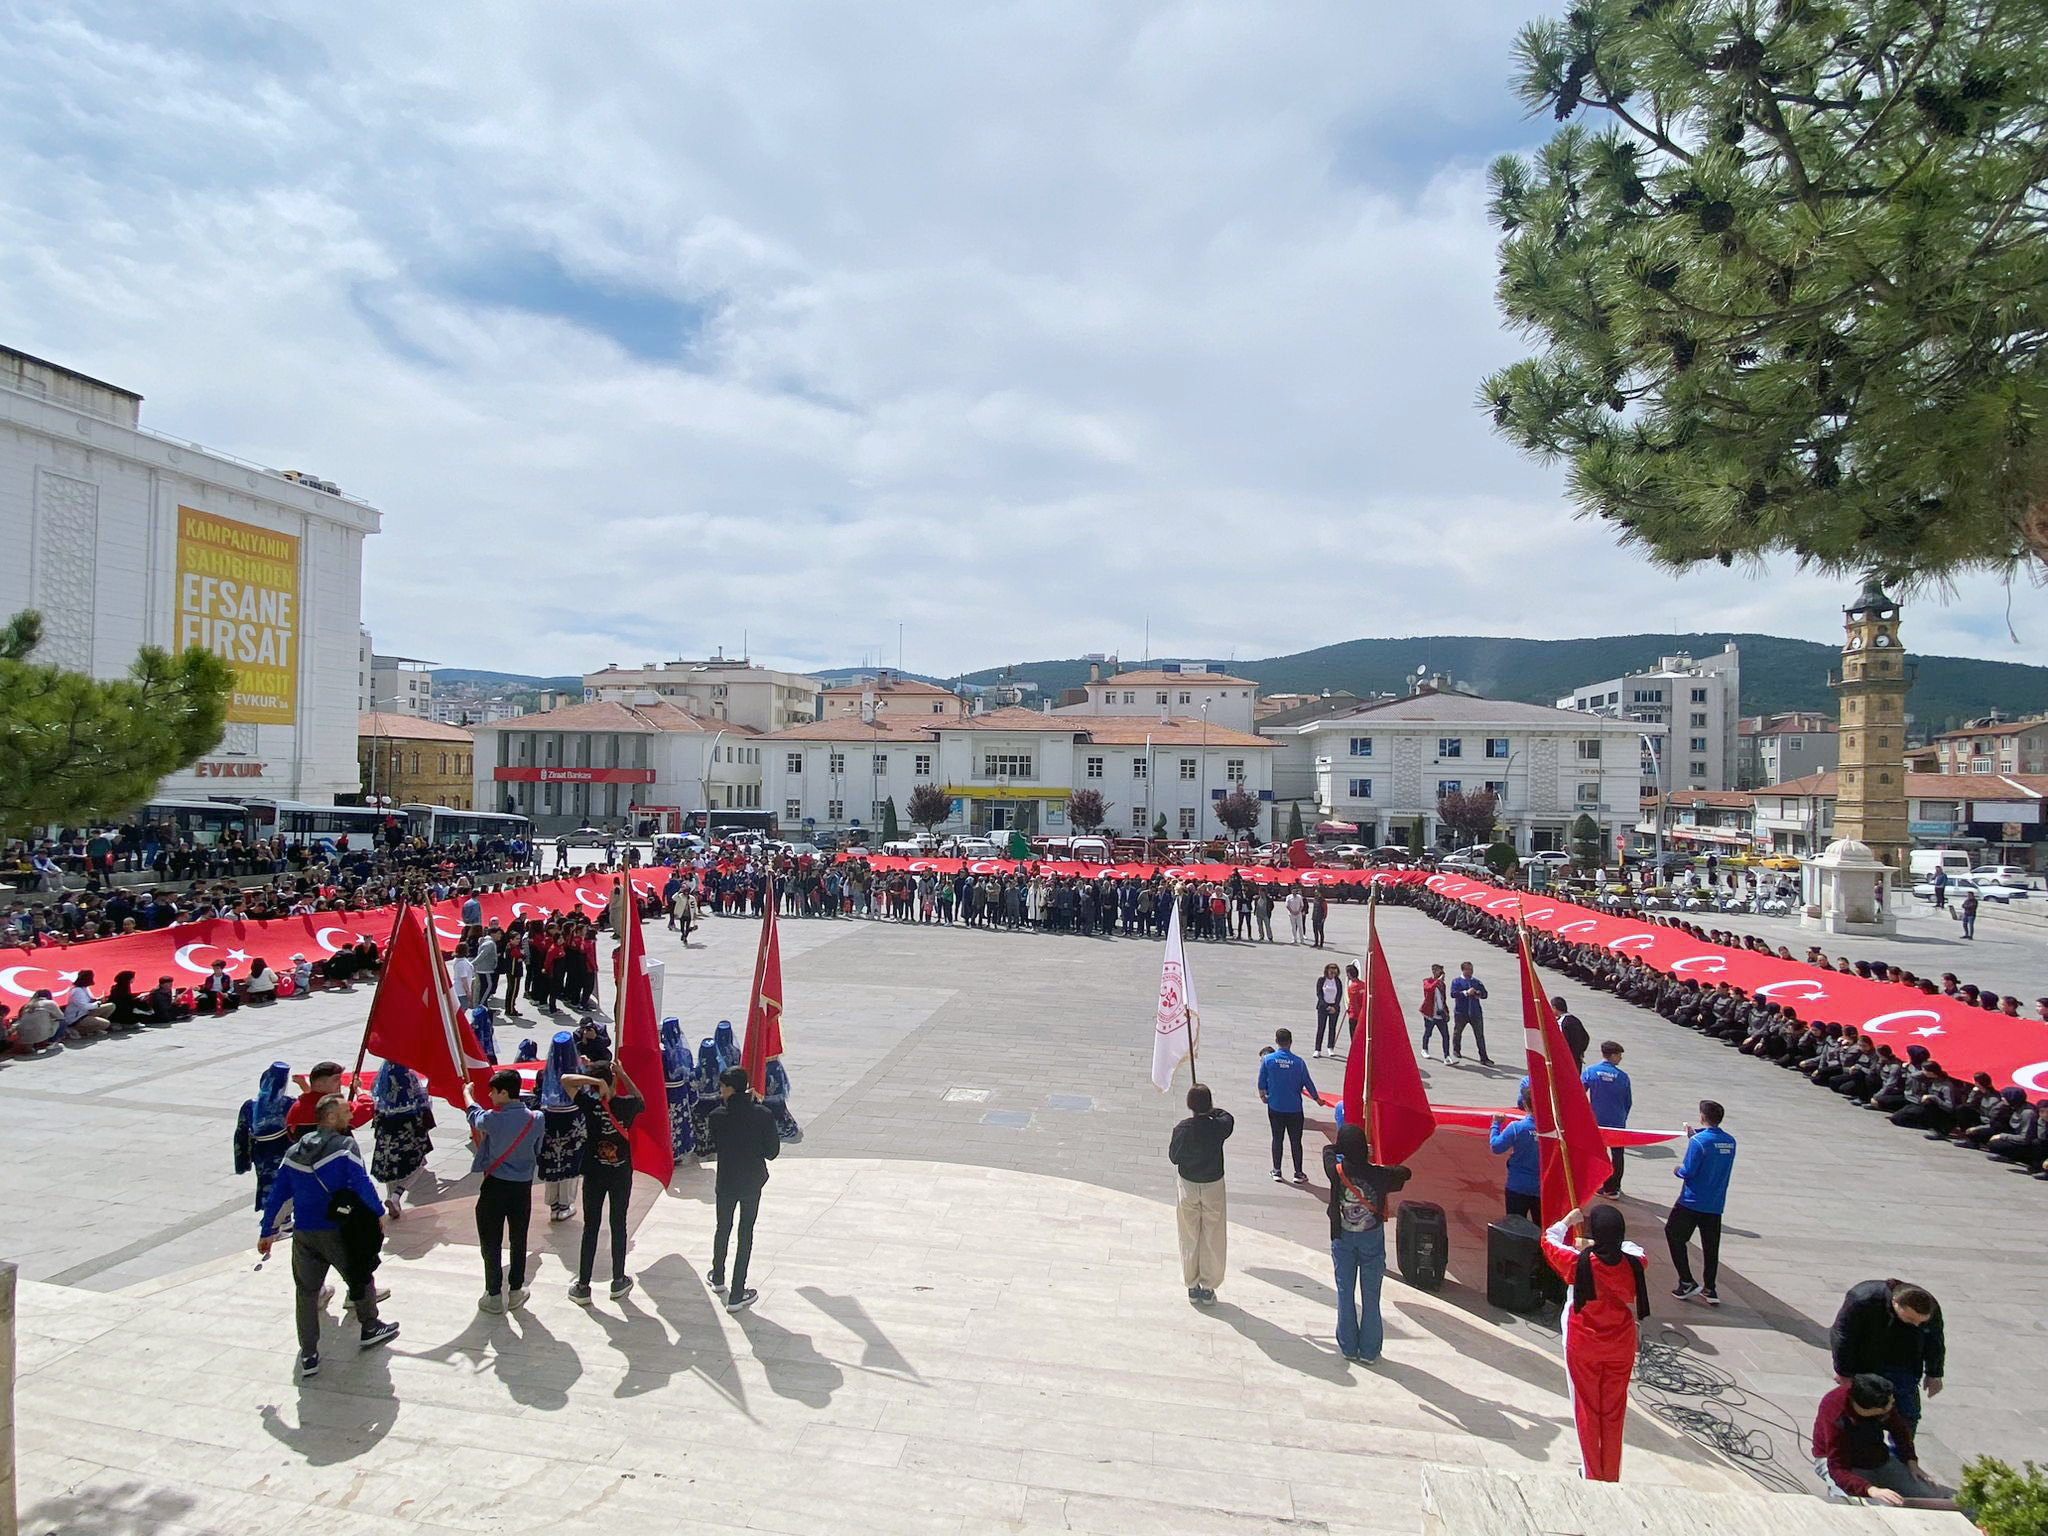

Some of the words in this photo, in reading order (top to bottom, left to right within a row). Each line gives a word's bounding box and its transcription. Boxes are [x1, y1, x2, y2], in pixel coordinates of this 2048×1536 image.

[185, 517, 289, 560] KAMPANYANIN
[183, 573, 292, 628] EFSANE
[182, 614, 292, 667] FIRSAT
[196, 762, 264, 778] EVKUR
